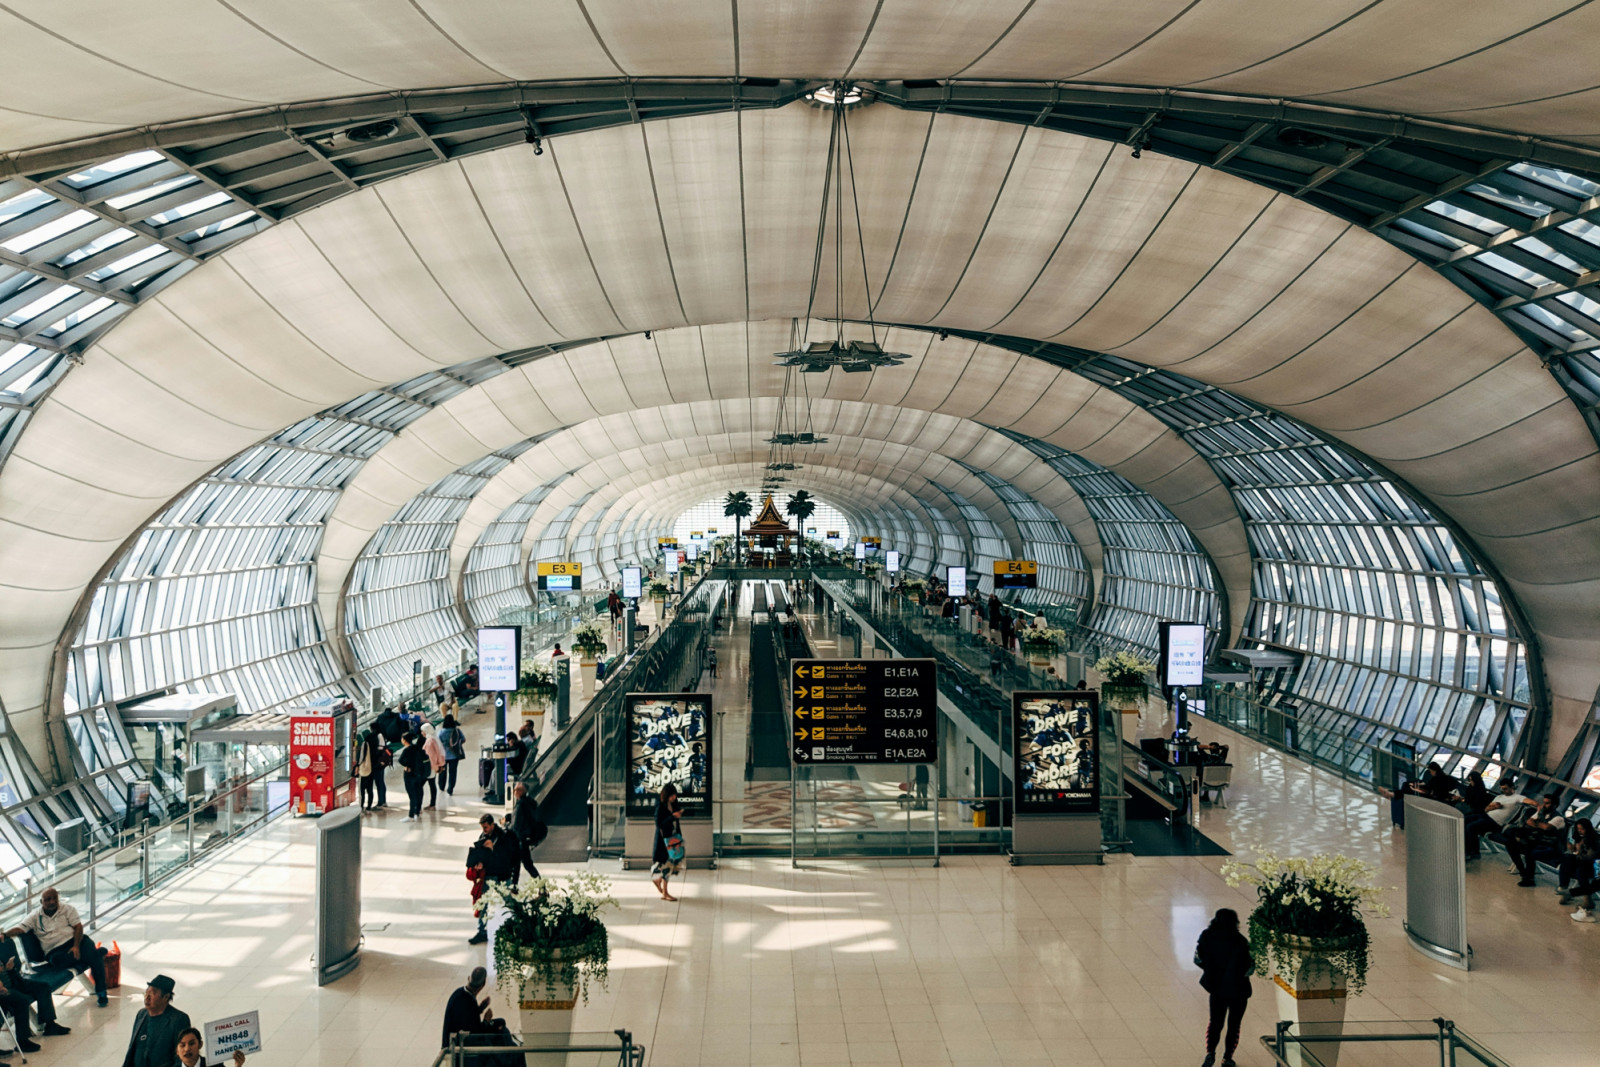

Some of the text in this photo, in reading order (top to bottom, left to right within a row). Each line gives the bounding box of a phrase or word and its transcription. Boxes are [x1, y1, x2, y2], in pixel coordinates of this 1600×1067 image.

[553, 564, 566, 574] E3
[1008, 562, 1022, 572] E4
[885, 668, 919, 677] E1,E1A
[884, 688, 918, 698] E2,E2A
[884, 709, 922, 719] E3,5,7,9
[294, 722, 331, 734] SNACK
[885, 729, 928, 738] E4,6,8,10
[293, 735, 332, 746] &DRINK
[885, 749, 926, 758] E1A,E2A
[648, 766, 691, 788] MORE
[1036, 762, 1078, 784] MORE
[215, 1023, 233, 1031] FINAL
[218, 1030, 249, 1044] NH848
[215, 1044, 243, 1056] HANEDA
